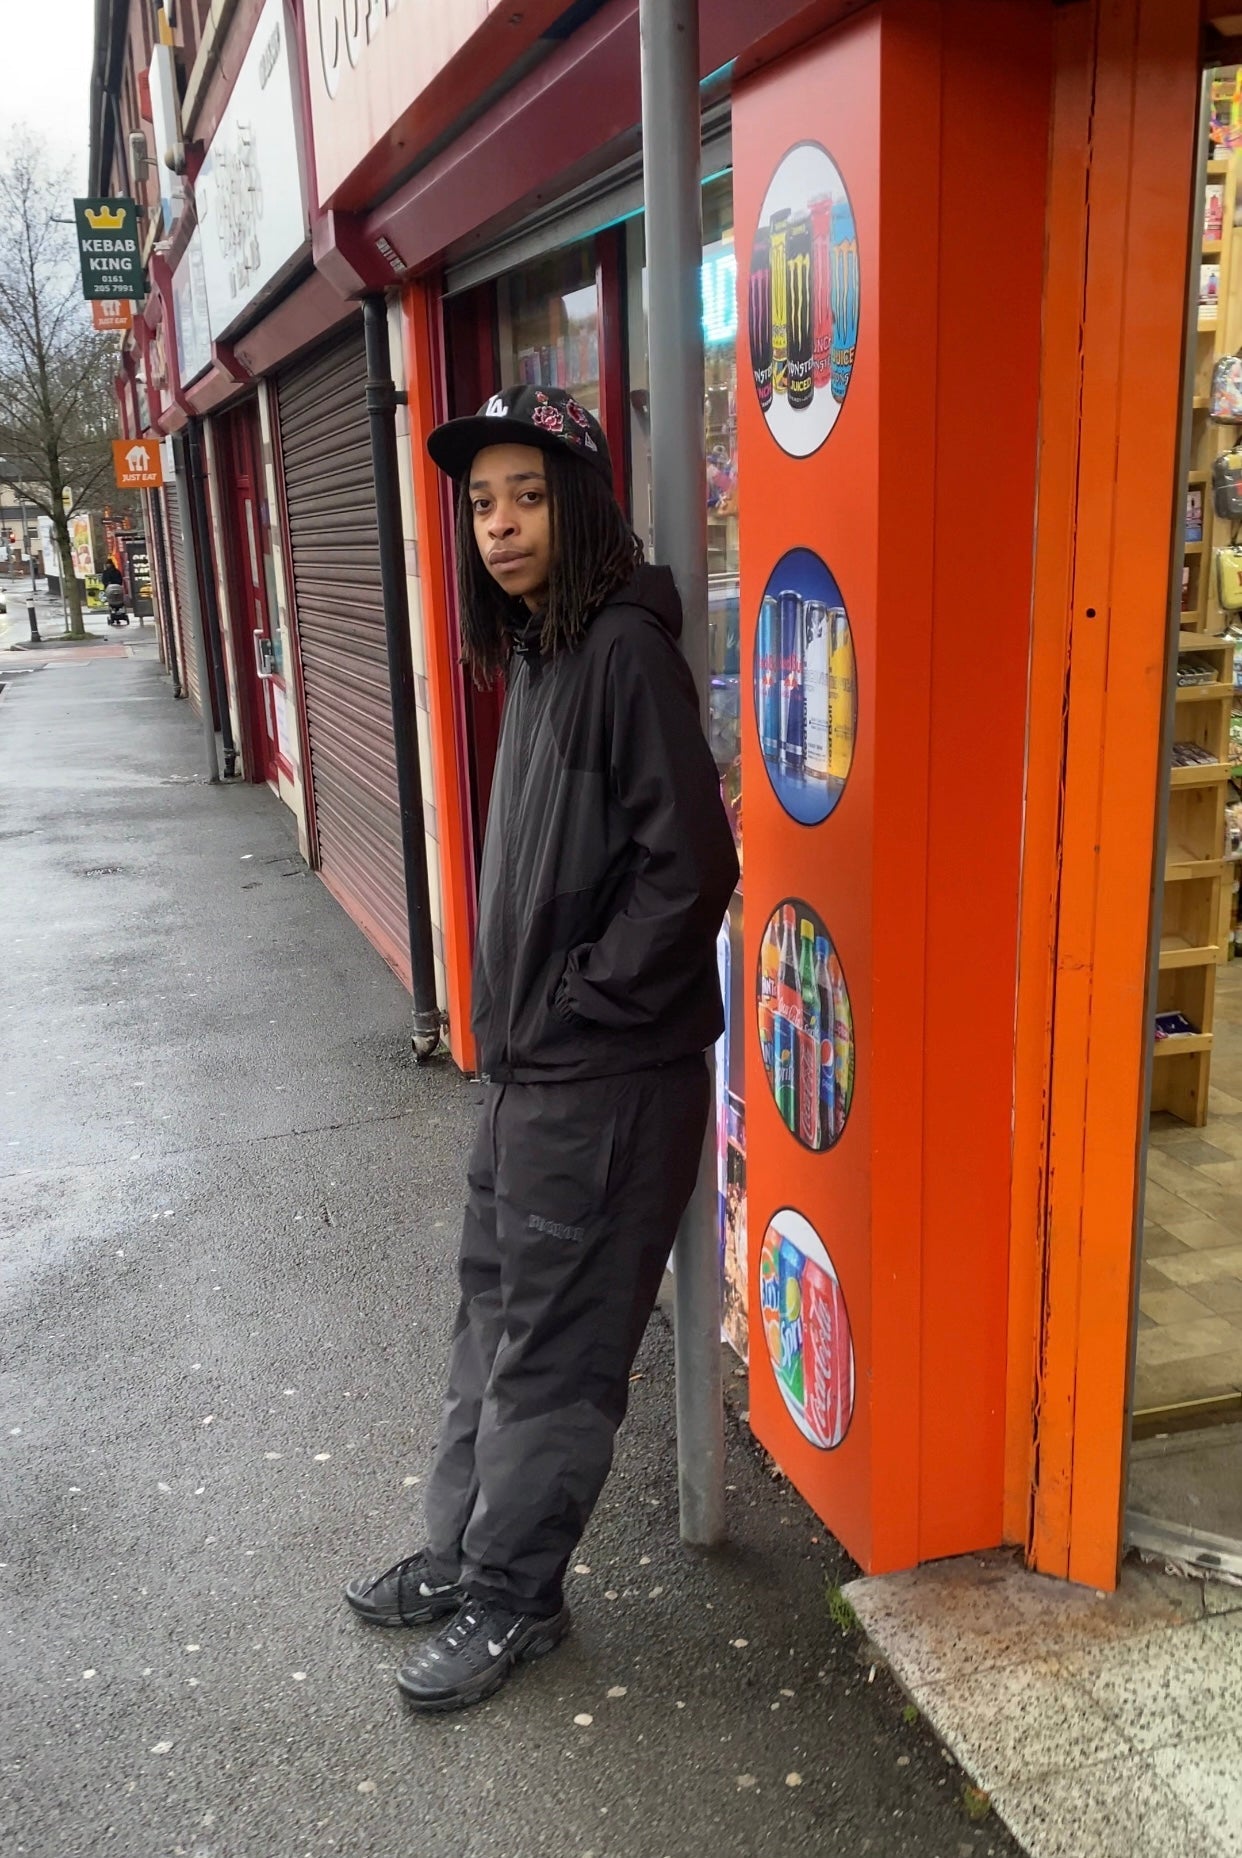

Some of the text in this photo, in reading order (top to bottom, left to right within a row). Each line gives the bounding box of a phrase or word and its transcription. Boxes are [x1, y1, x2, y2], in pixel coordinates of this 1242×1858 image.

[81, 239, 136, 252] KEBAB
[89, 258, 132, 270] KING
[101, 275, 123, 283] 0161
[112, 284, 134, 292] 7991
[122, 473, 157, 482] JUST EAT
